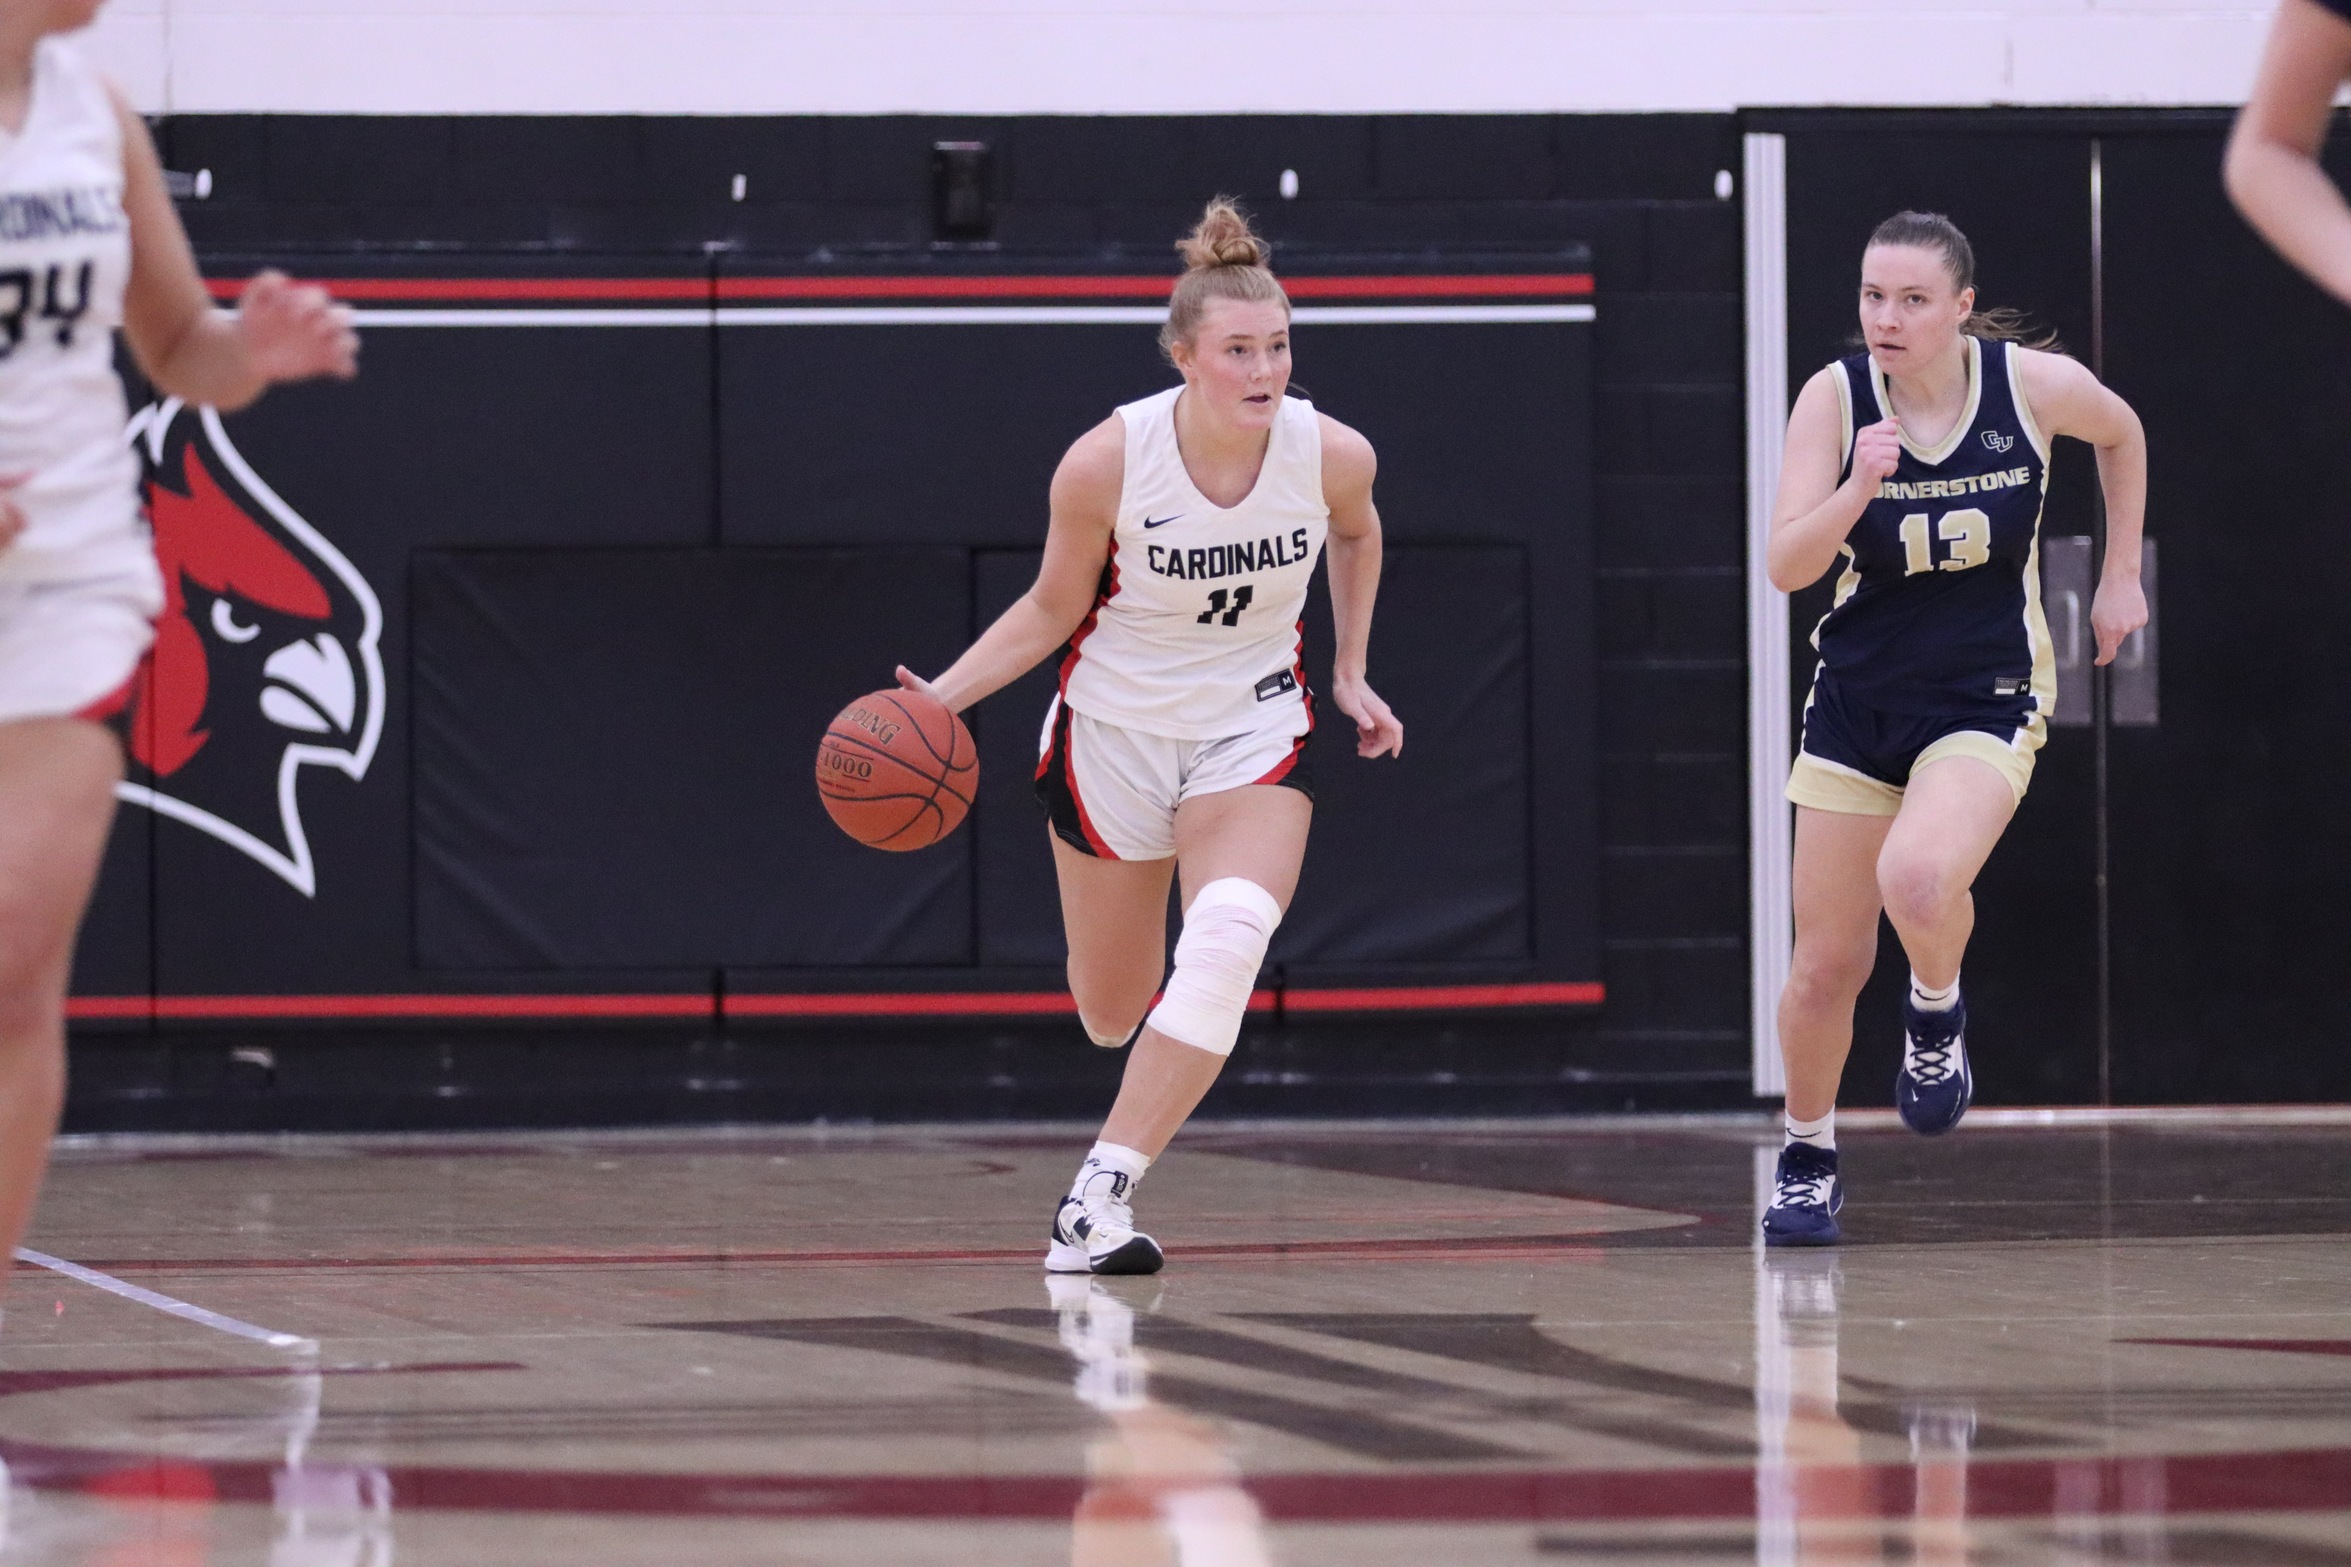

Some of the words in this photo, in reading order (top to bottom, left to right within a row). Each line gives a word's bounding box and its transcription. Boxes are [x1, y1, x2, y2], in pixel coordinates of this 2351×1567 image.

[1148, 527, 1308, 580] CARDINALS
[1899, 508, 1992, 577] 13
[1196, 584, 1254, 627] 11
